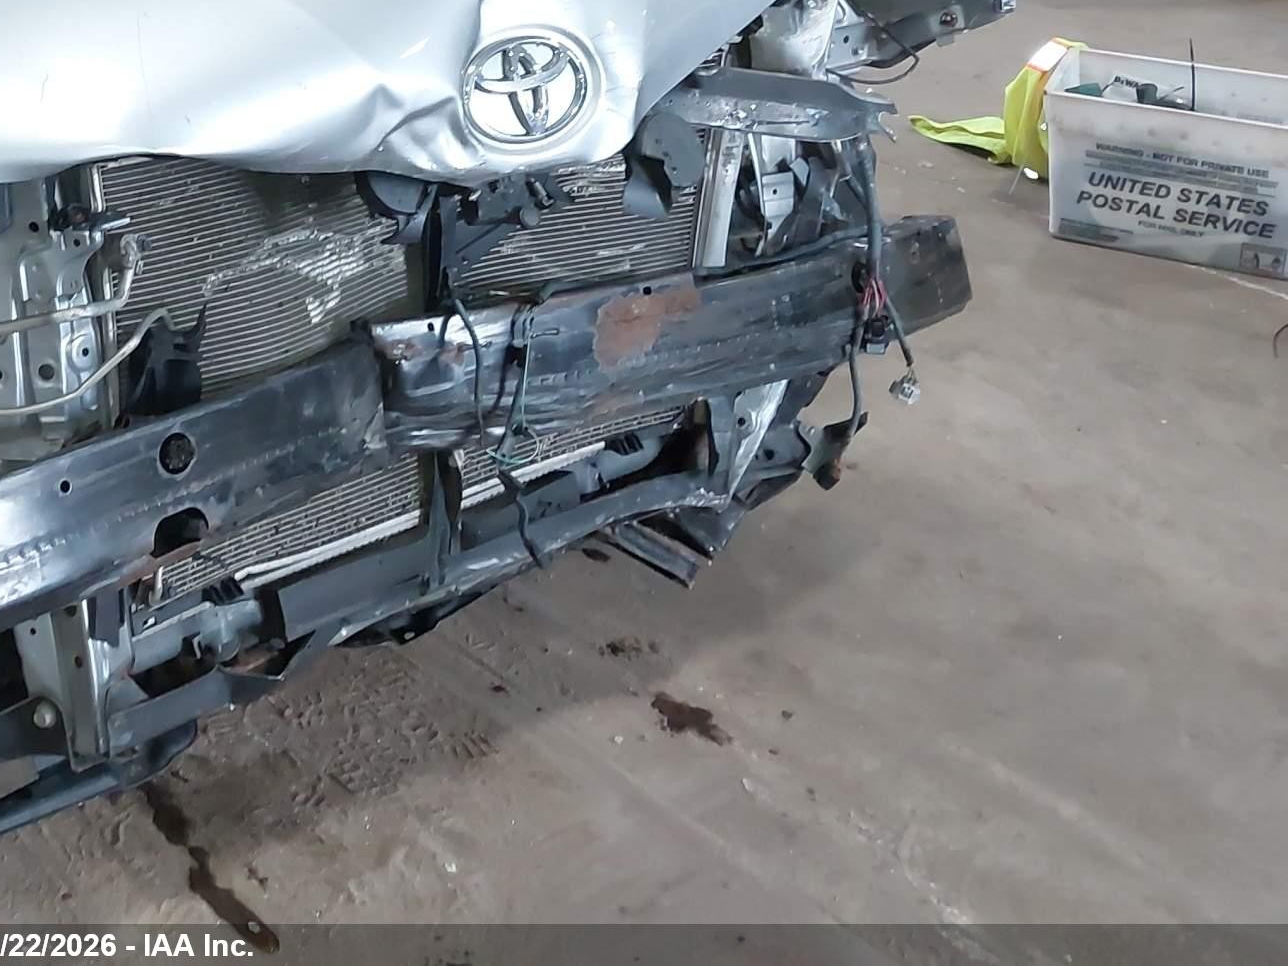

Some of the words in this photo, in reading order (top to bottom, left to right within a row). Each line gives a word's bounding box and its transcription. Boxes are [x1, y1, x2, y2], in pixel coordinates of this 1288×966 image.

[1096, 143, 1144, 157] WARNING
[1152, 152, 1174, 162] NOT
[1176, 155, 1198, 167] FOR
[1200, 160, 1245, 175] PRIVATE
[1247, 167, 1269, 178] USE
[1076, 190, 1165, 220] POSTAL
[1173, 208, 1278, 239] SERVICE
[1088, 172, 1171, 199] UNITED
[1177, 187, 1269, 216] STATES
